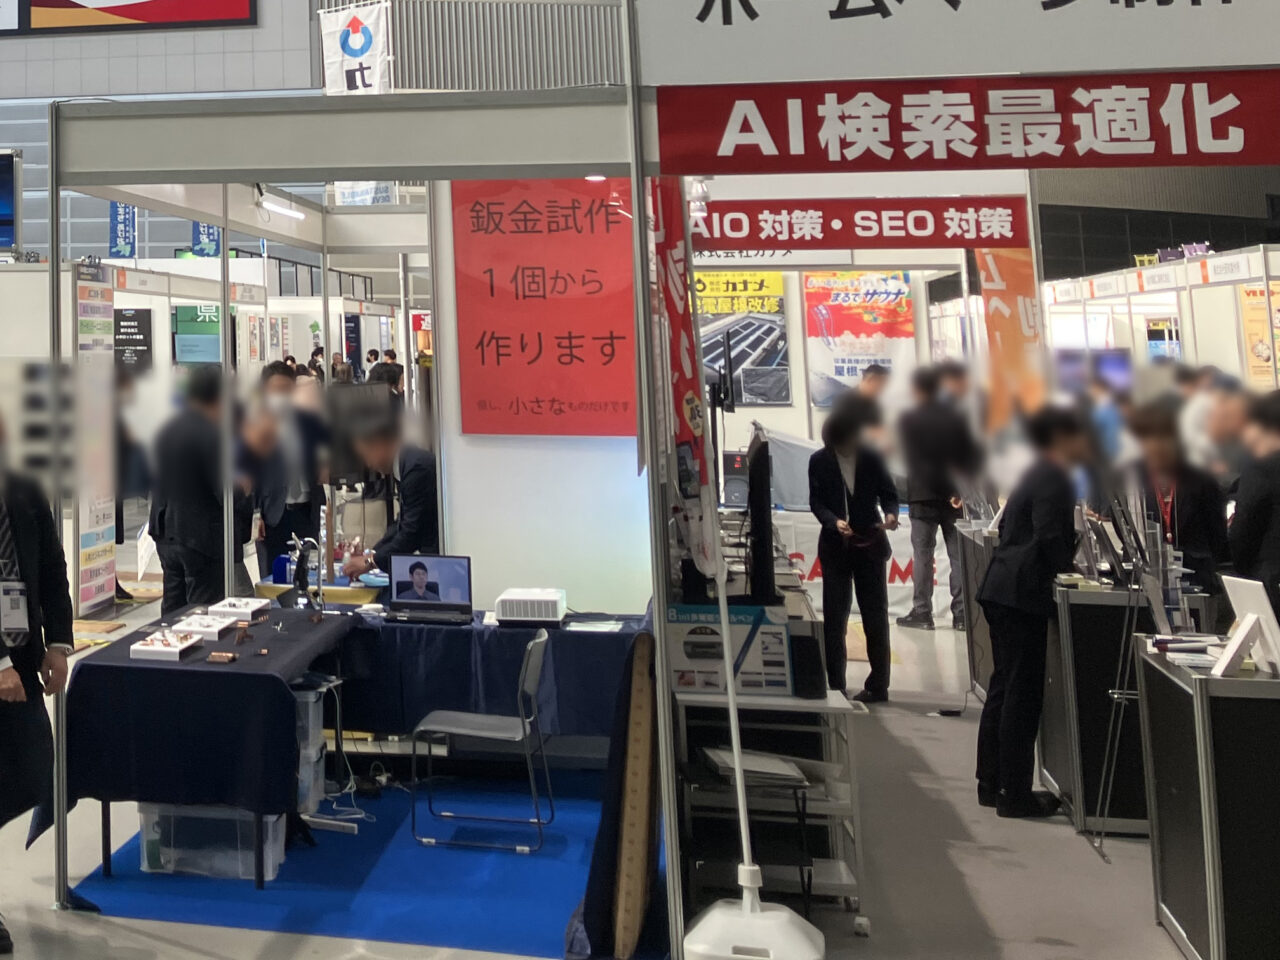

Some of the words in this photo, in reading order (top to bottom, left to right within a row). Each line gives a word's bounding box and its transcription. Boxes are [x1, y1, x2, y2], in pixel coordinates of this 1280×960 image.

[716, 82, 1246, 163] AI検索最適化
[469, 198, 622, 235] 鈑金試作
[689, 211, 750, 239] AIO
[943, 207, 1014, 240] 対策
[474, 330, 627, 366] 作ります
